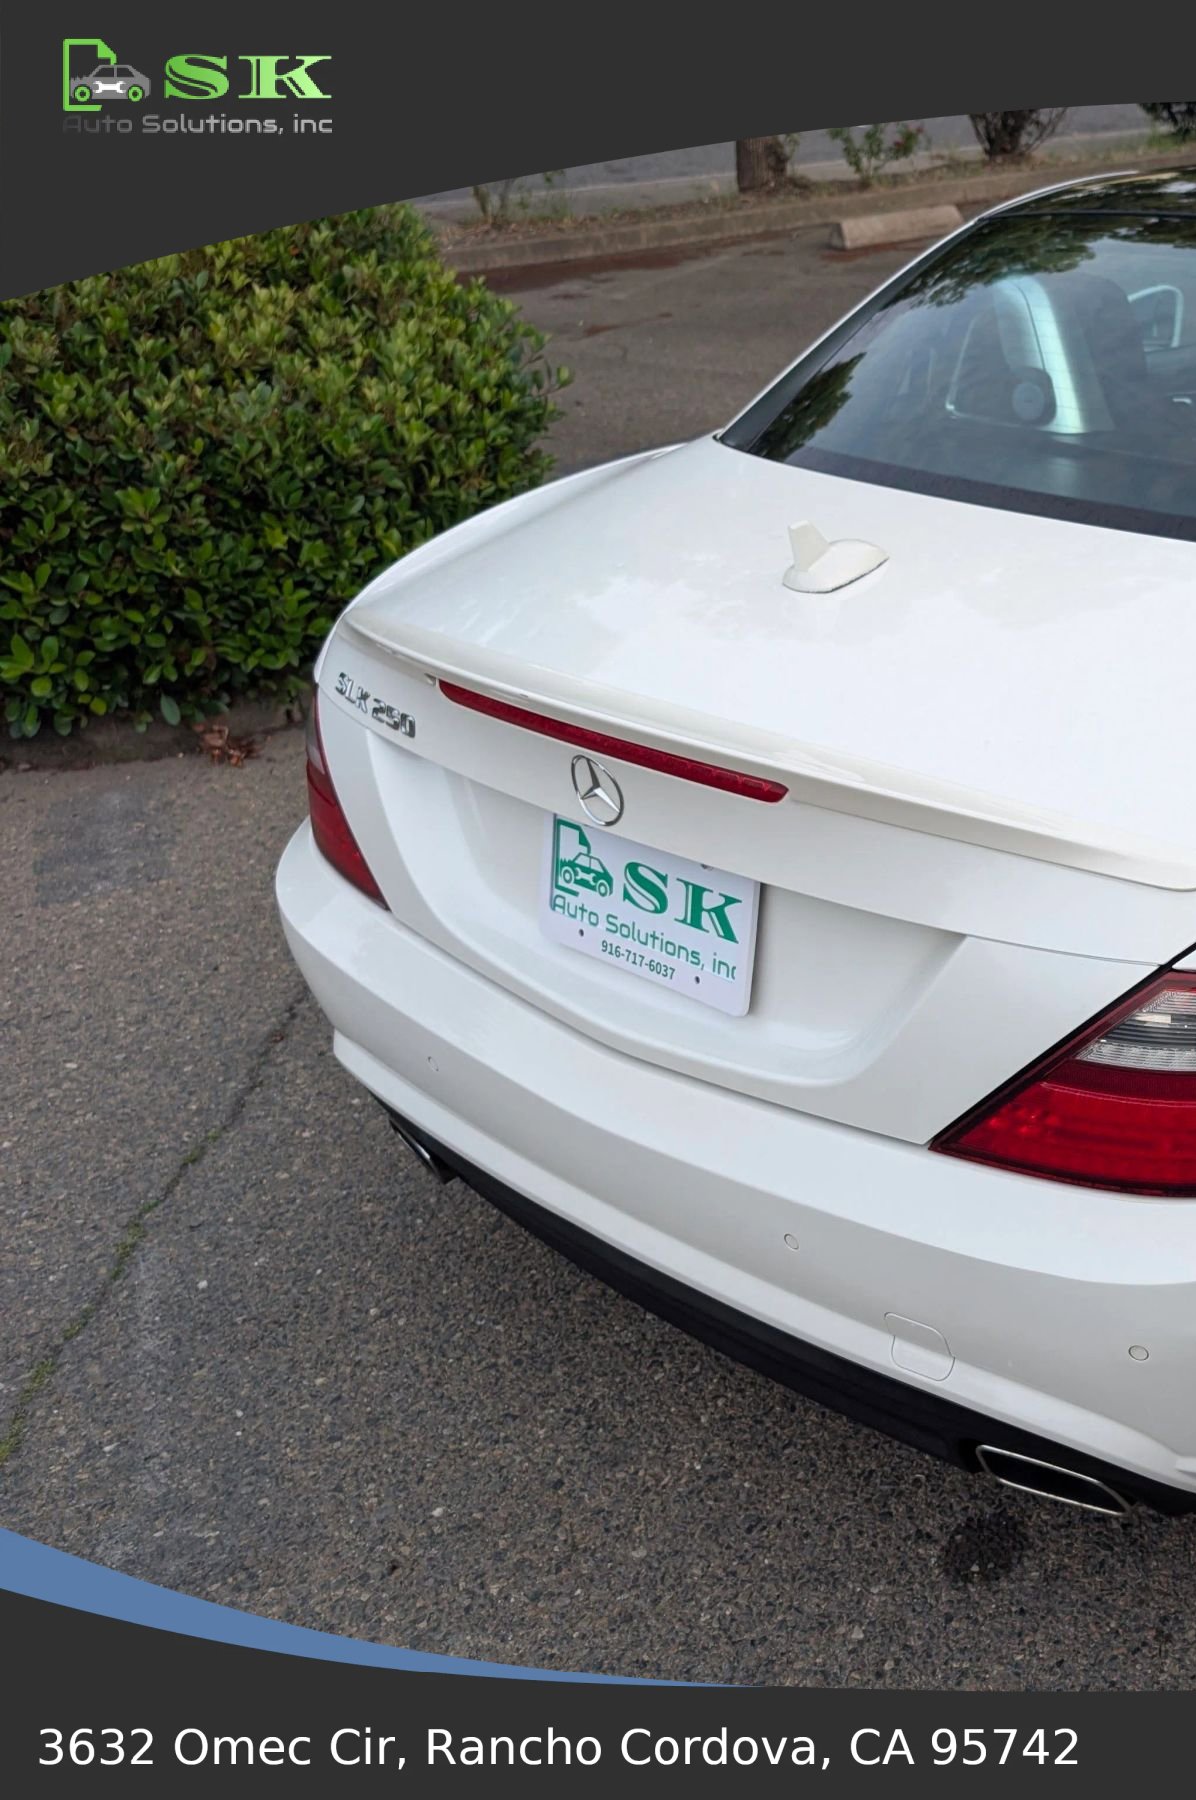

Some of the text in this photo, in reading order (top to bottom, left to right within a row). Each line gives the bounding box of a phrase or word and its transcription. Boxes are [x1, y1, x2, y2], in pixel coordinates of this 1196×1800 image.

[334, 672, 416, 738] SLK 250
[552, 893, 600, 927] Auto
[605, 913, 704, 970] Solutions,
[622, 861, 743, 944] SK
[601, 938, 676, 980] 916-717-6037
